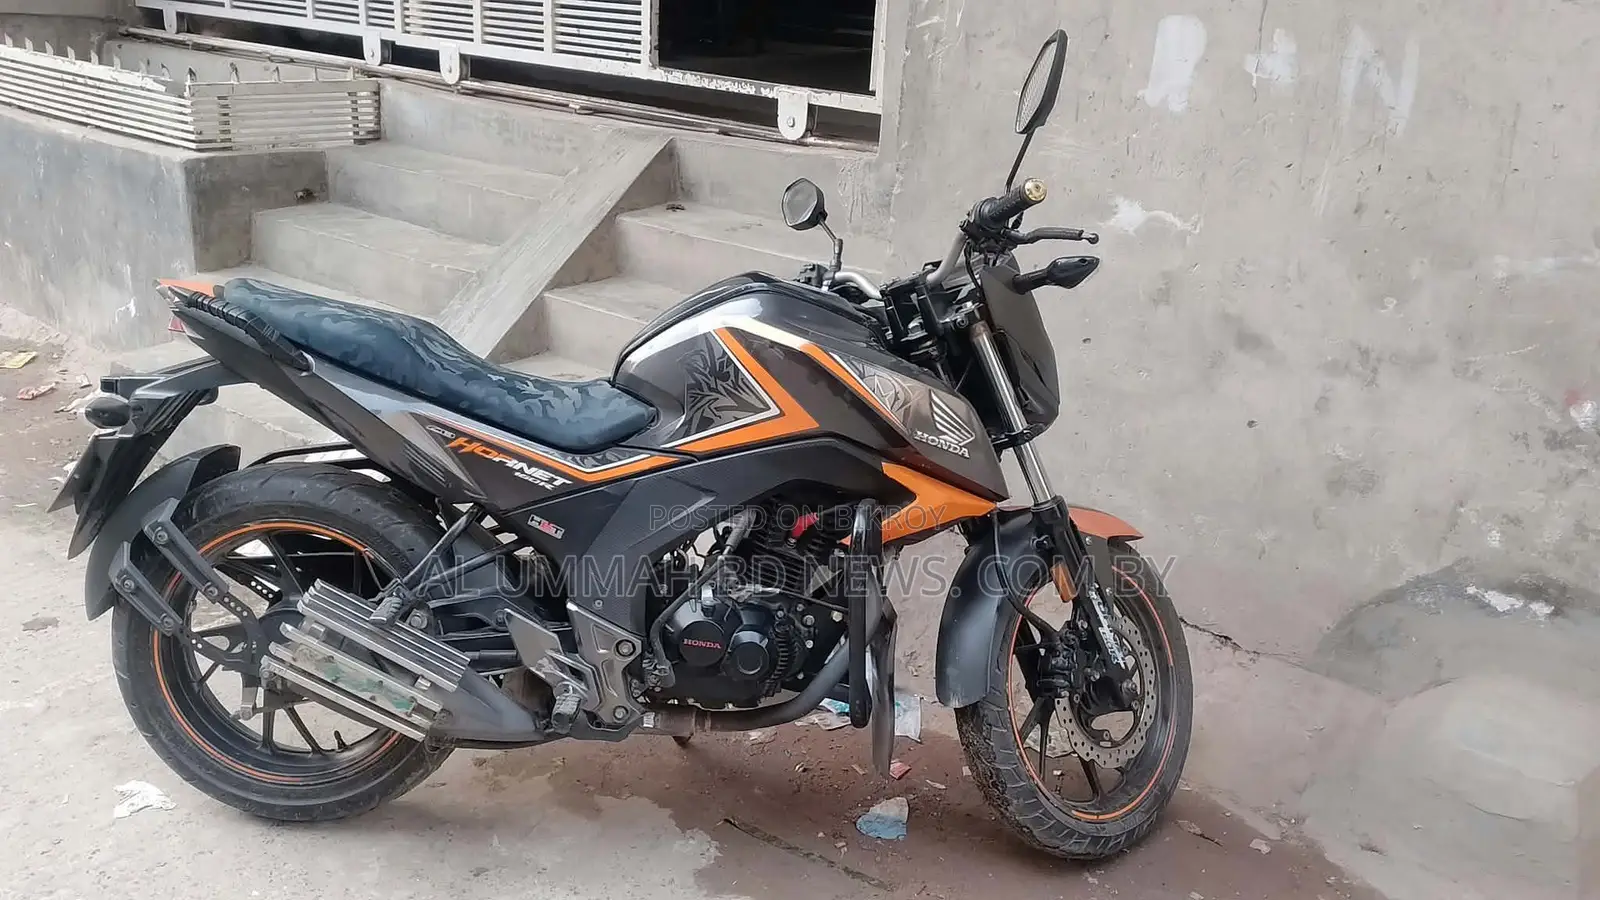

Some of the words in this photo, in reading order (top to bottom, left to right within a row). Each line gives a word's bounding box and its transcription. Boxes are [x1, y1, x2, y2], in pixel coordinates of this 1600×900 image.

[913, 430, 970, 459] HONDA
[445, 437, 573, 486] HORNET
[683, 638, 722, 649] HONDA
